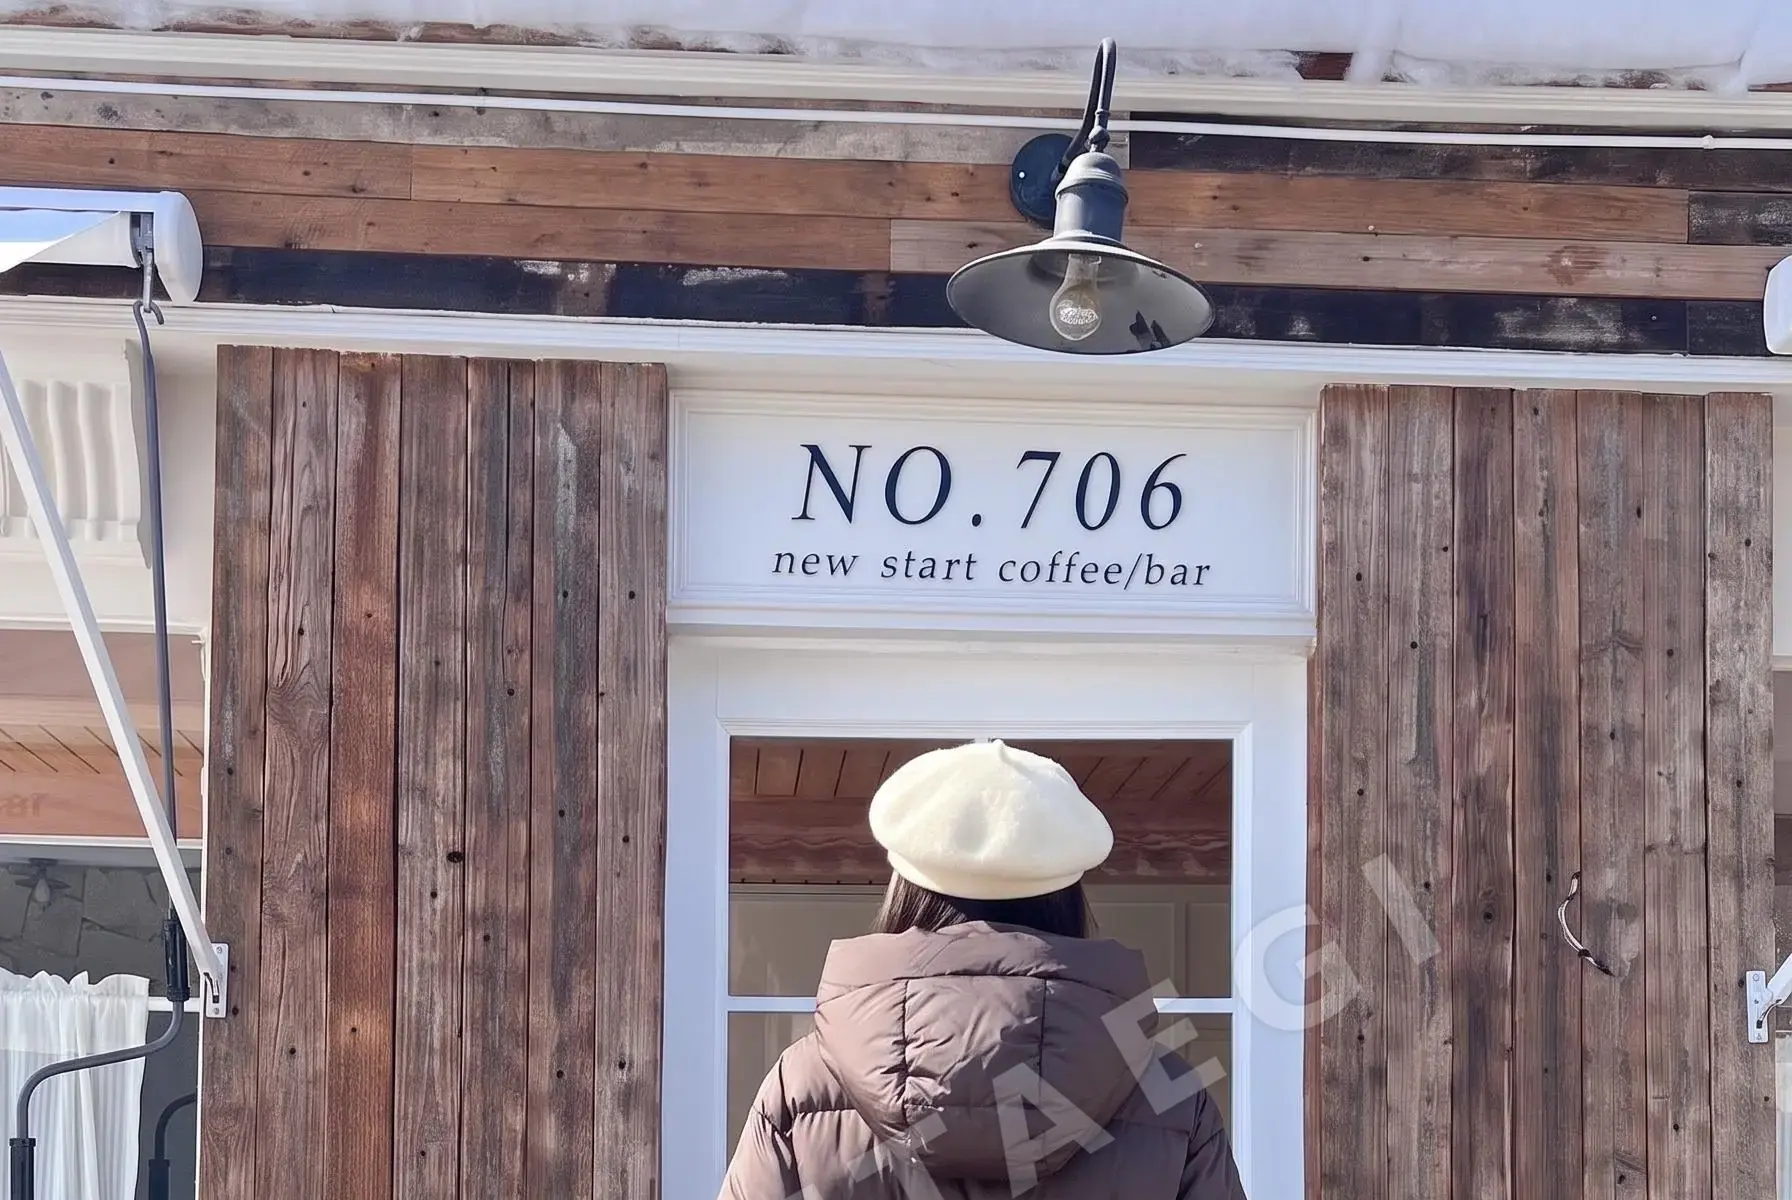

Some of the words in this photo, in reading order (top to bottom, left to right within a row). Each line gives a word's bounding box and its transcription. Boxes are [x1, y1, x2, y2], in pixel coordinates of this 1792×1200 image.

[791, 444, 983, 528] NO.
[1016, 449, 1189, 531] 706
[771, 551, 860, 578] new
[880, 551, 978, 581] start
[998, 550, 1212, 591] coffee/bar
